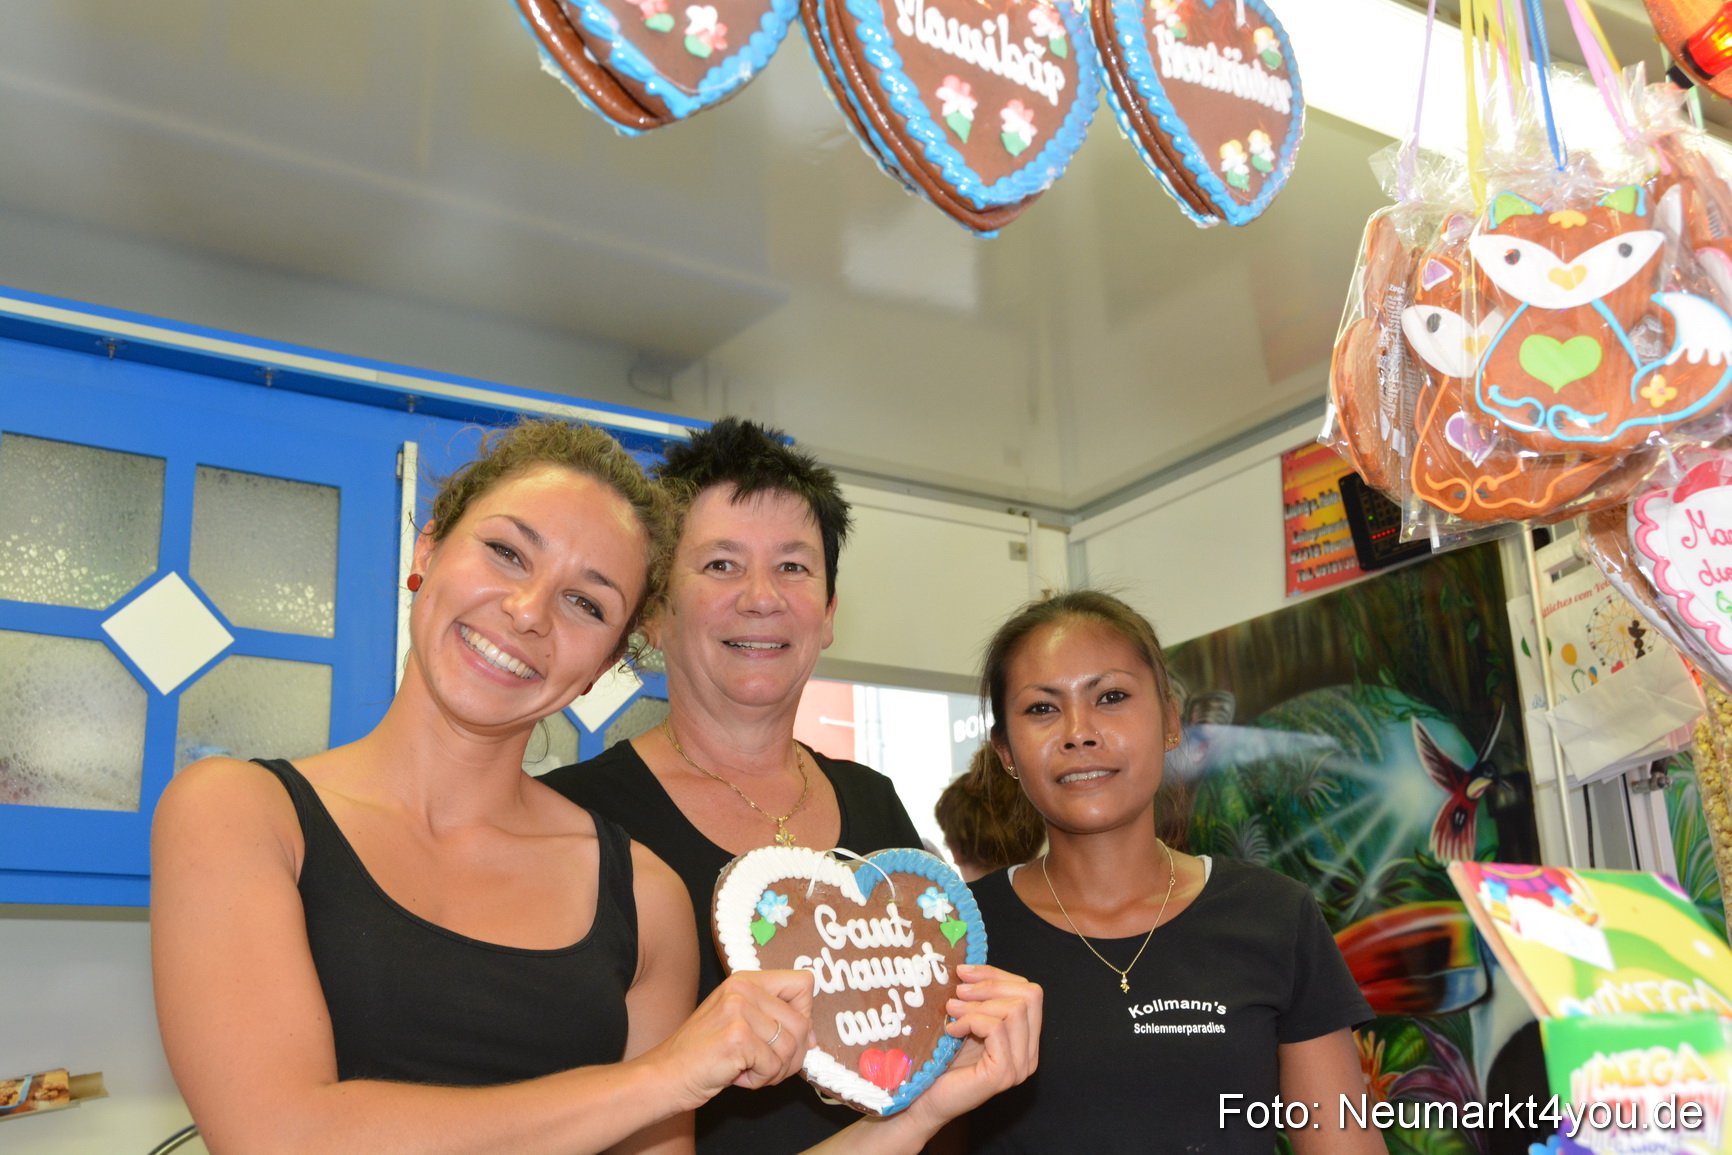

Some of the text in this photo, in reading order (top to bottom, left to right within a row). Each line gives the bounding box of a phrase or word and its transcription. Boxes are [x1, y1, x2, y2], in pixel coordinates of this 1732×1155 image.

[835, 988, 912, 1046] aus!
[1128, 999, 1227, 1018] Kollmann's
[1134, 1022, 1226, 1036] Schlemmerparadies
[1594, 1042, 1712, 1090] MEGA
